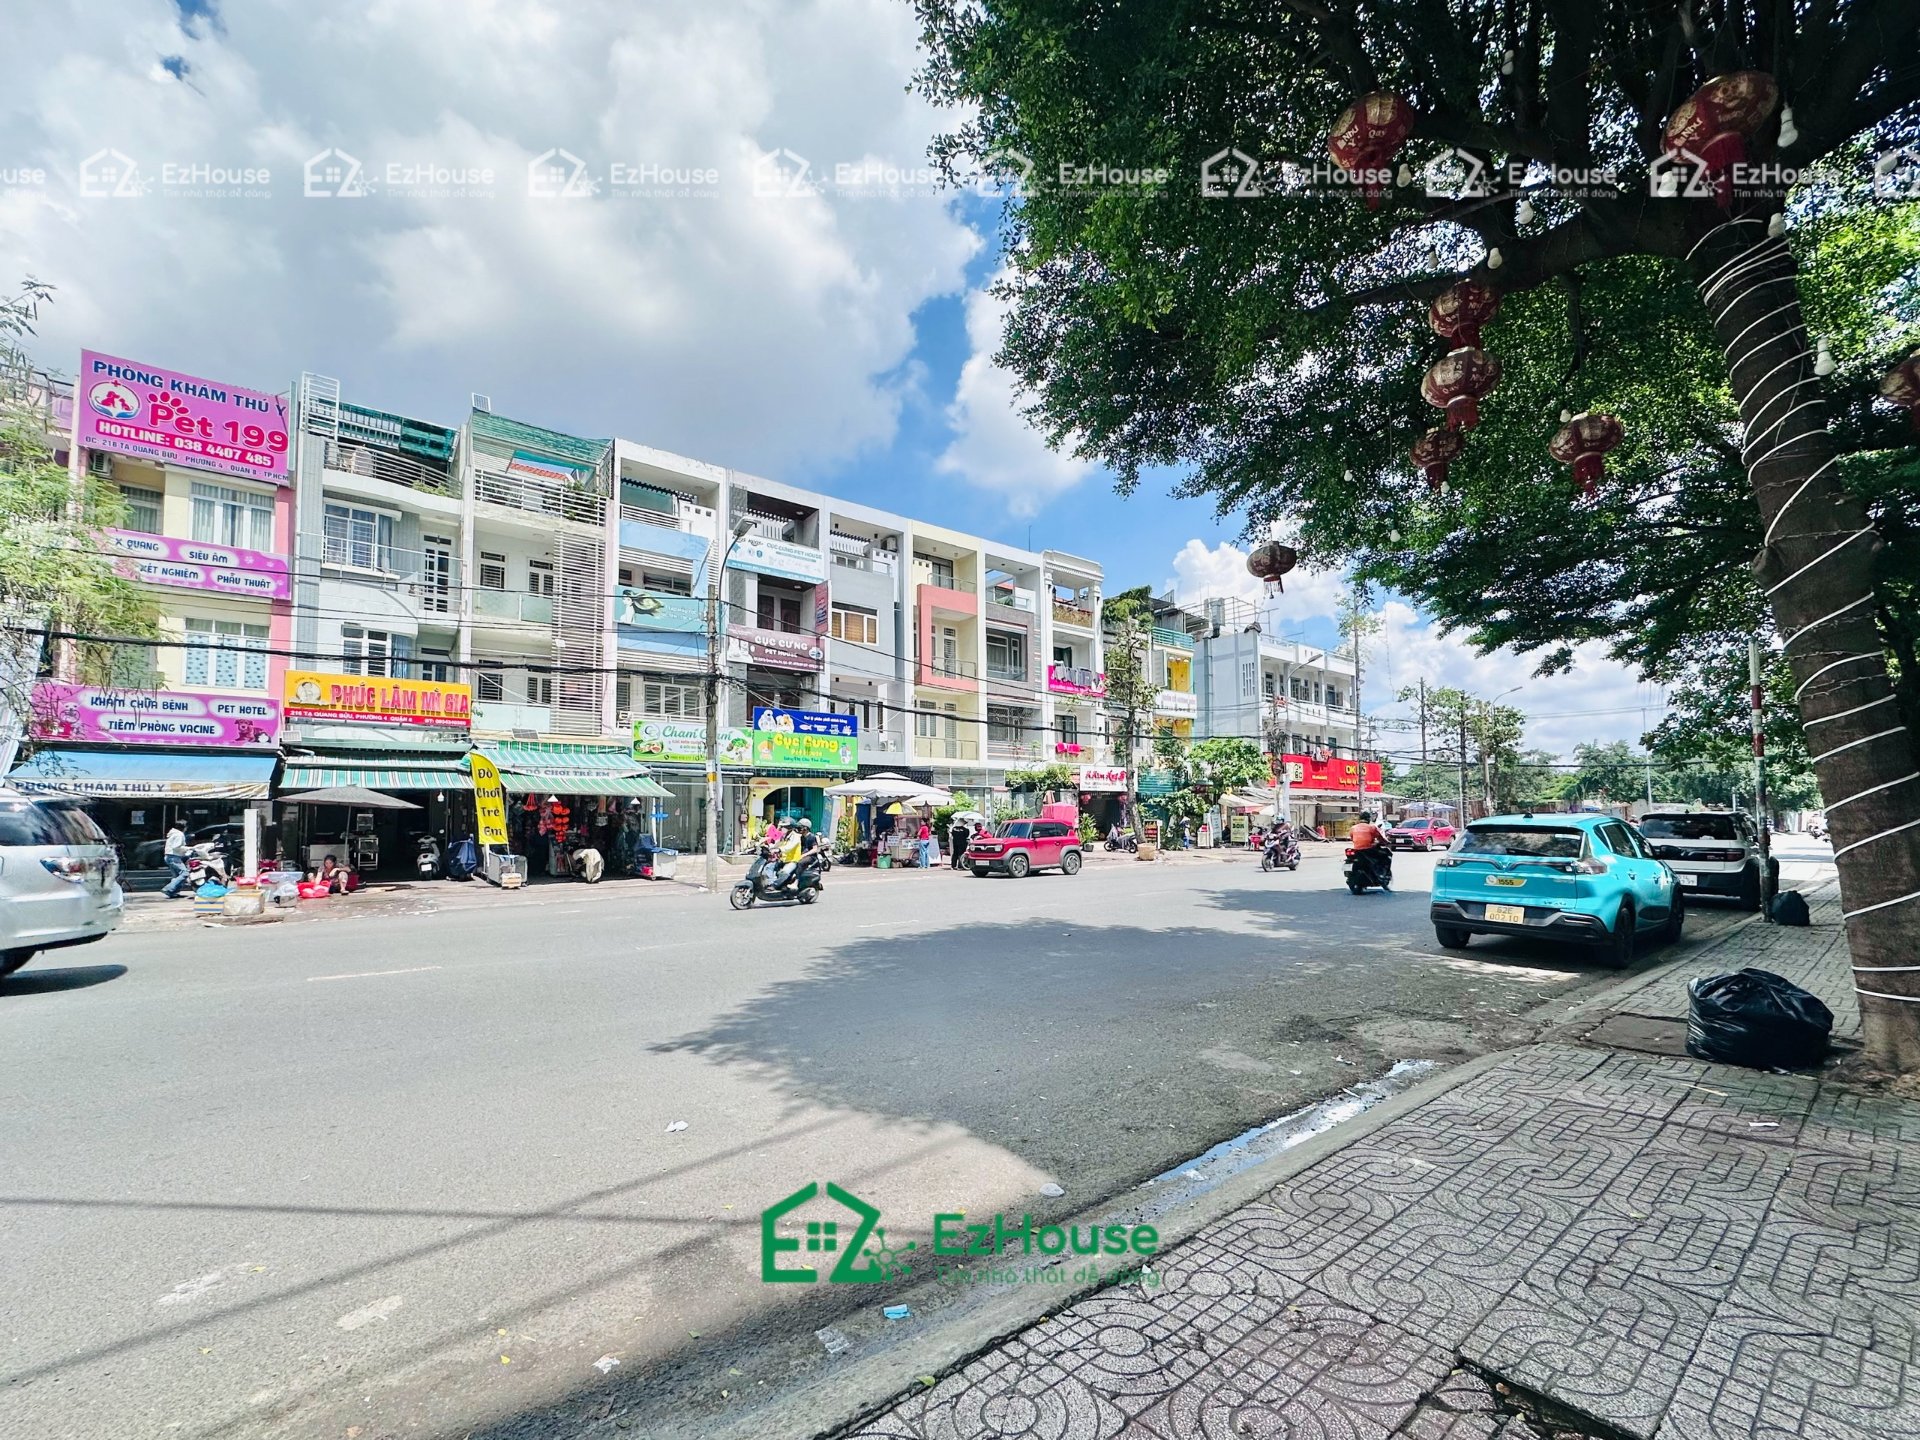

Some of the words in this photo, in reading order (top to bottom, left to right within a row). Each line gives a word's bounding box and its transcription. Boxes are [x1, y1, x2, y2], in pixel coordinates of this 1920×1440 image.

[93, 359, 164, 389] PHÒNG
[170, 377, 227, 404] KHÁM
[233, 394, 269, 413] THÚ
[276, 404, 287, 417] Y
[148, 403, 214, 440] Pet
[224, 420, 289, 454] 199
[99, 420, 171, 446] HOTLINE:
[174, 436, 202, 451] 038
[207, 444, 241, 462] 4407
[245, 452, 272, 467] 485
[132, 445, 159, 456] QUANG
[115, 537, 123, 546] X
[127, 539, 159, 551] QUANG
[189, 550, 209, 561] SIÊU
[212, 551, 228, 563] ÂM
[754, 635, 776, 647] CỤC
[90, 695, 125, 708] KHÁM
[162, 698, 189, 713] BỆNH
[330, 682, 376, 707] PHÚC
[380, 684, 417, 710] LÂM
[421, 687, 441, 711] MÌ
[444, 694, 469, 714] GIA
[217, 704, 236, 715] PET
[239, 704, 268, 716] HOTEL
[108, 719, 136, 732] TIÊM
[140, 719, 176, 733] PHÒNG
[180, 723, 216, 735] VACINE
[773, 733, 800, 750] Cục
[803, 734, 839, 753] Cưng
[477, 767, 493, 779] Đồ
[573, 769, 594, 777] TRẺ
[123, 781, 151, 791] THÚ
[156, 784, 165, 792] Y
[476, 787, 500, 798] Chơi
[480, 806, 500, 817] Trẻ
[484, 826, 502, 836] Em
[1497, 878, 1514, 886] 1555
